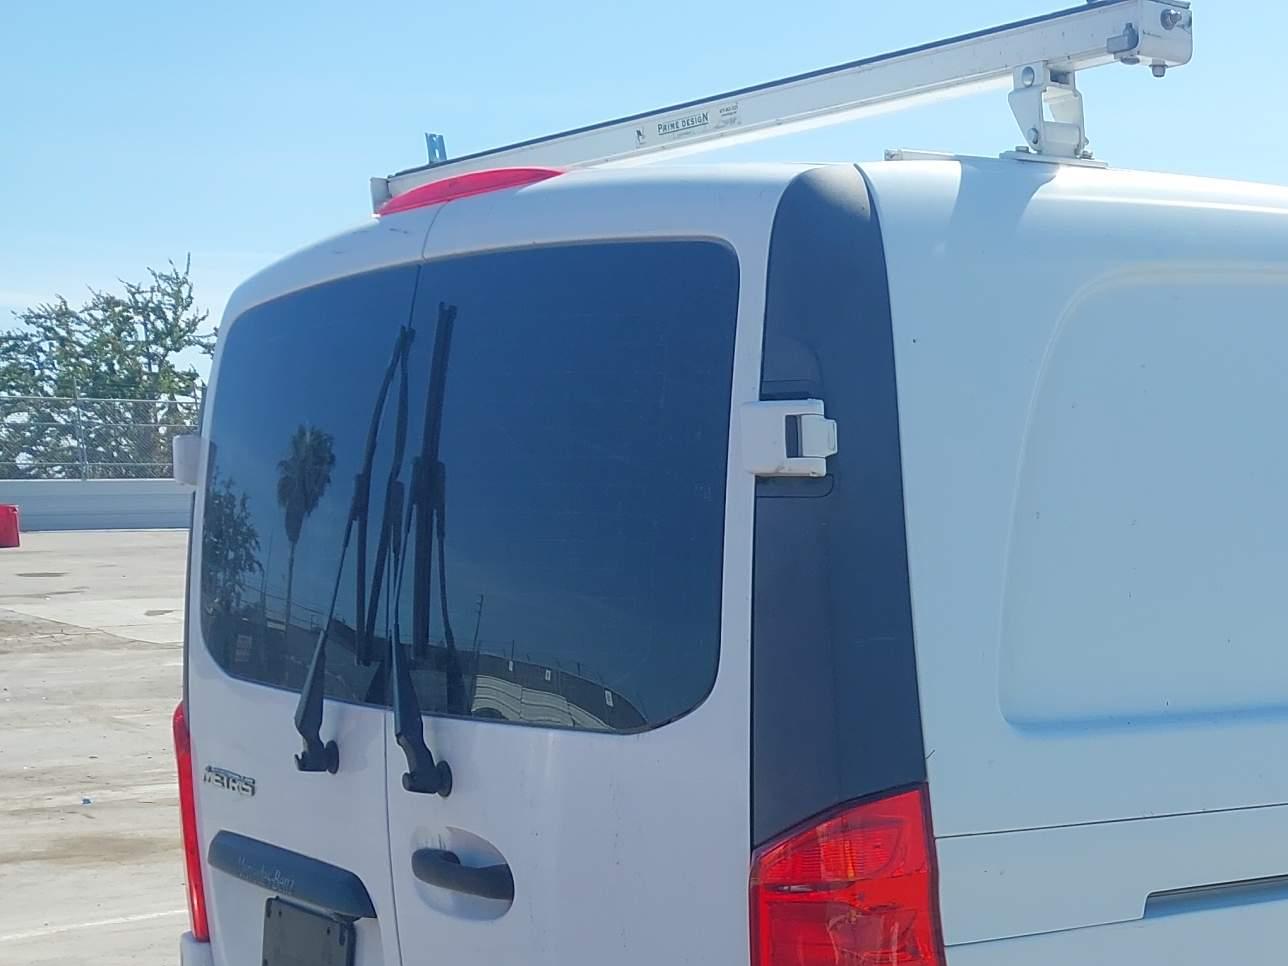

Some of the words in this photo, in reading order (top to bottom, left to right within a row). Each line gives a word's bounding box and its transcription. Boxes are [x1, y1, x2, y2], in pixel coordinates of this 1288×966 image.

[657, 120, 680, 134] PRIME
[681, 112, 710, 128] DESIGN
[202, 765, 257, 797] METRIS
